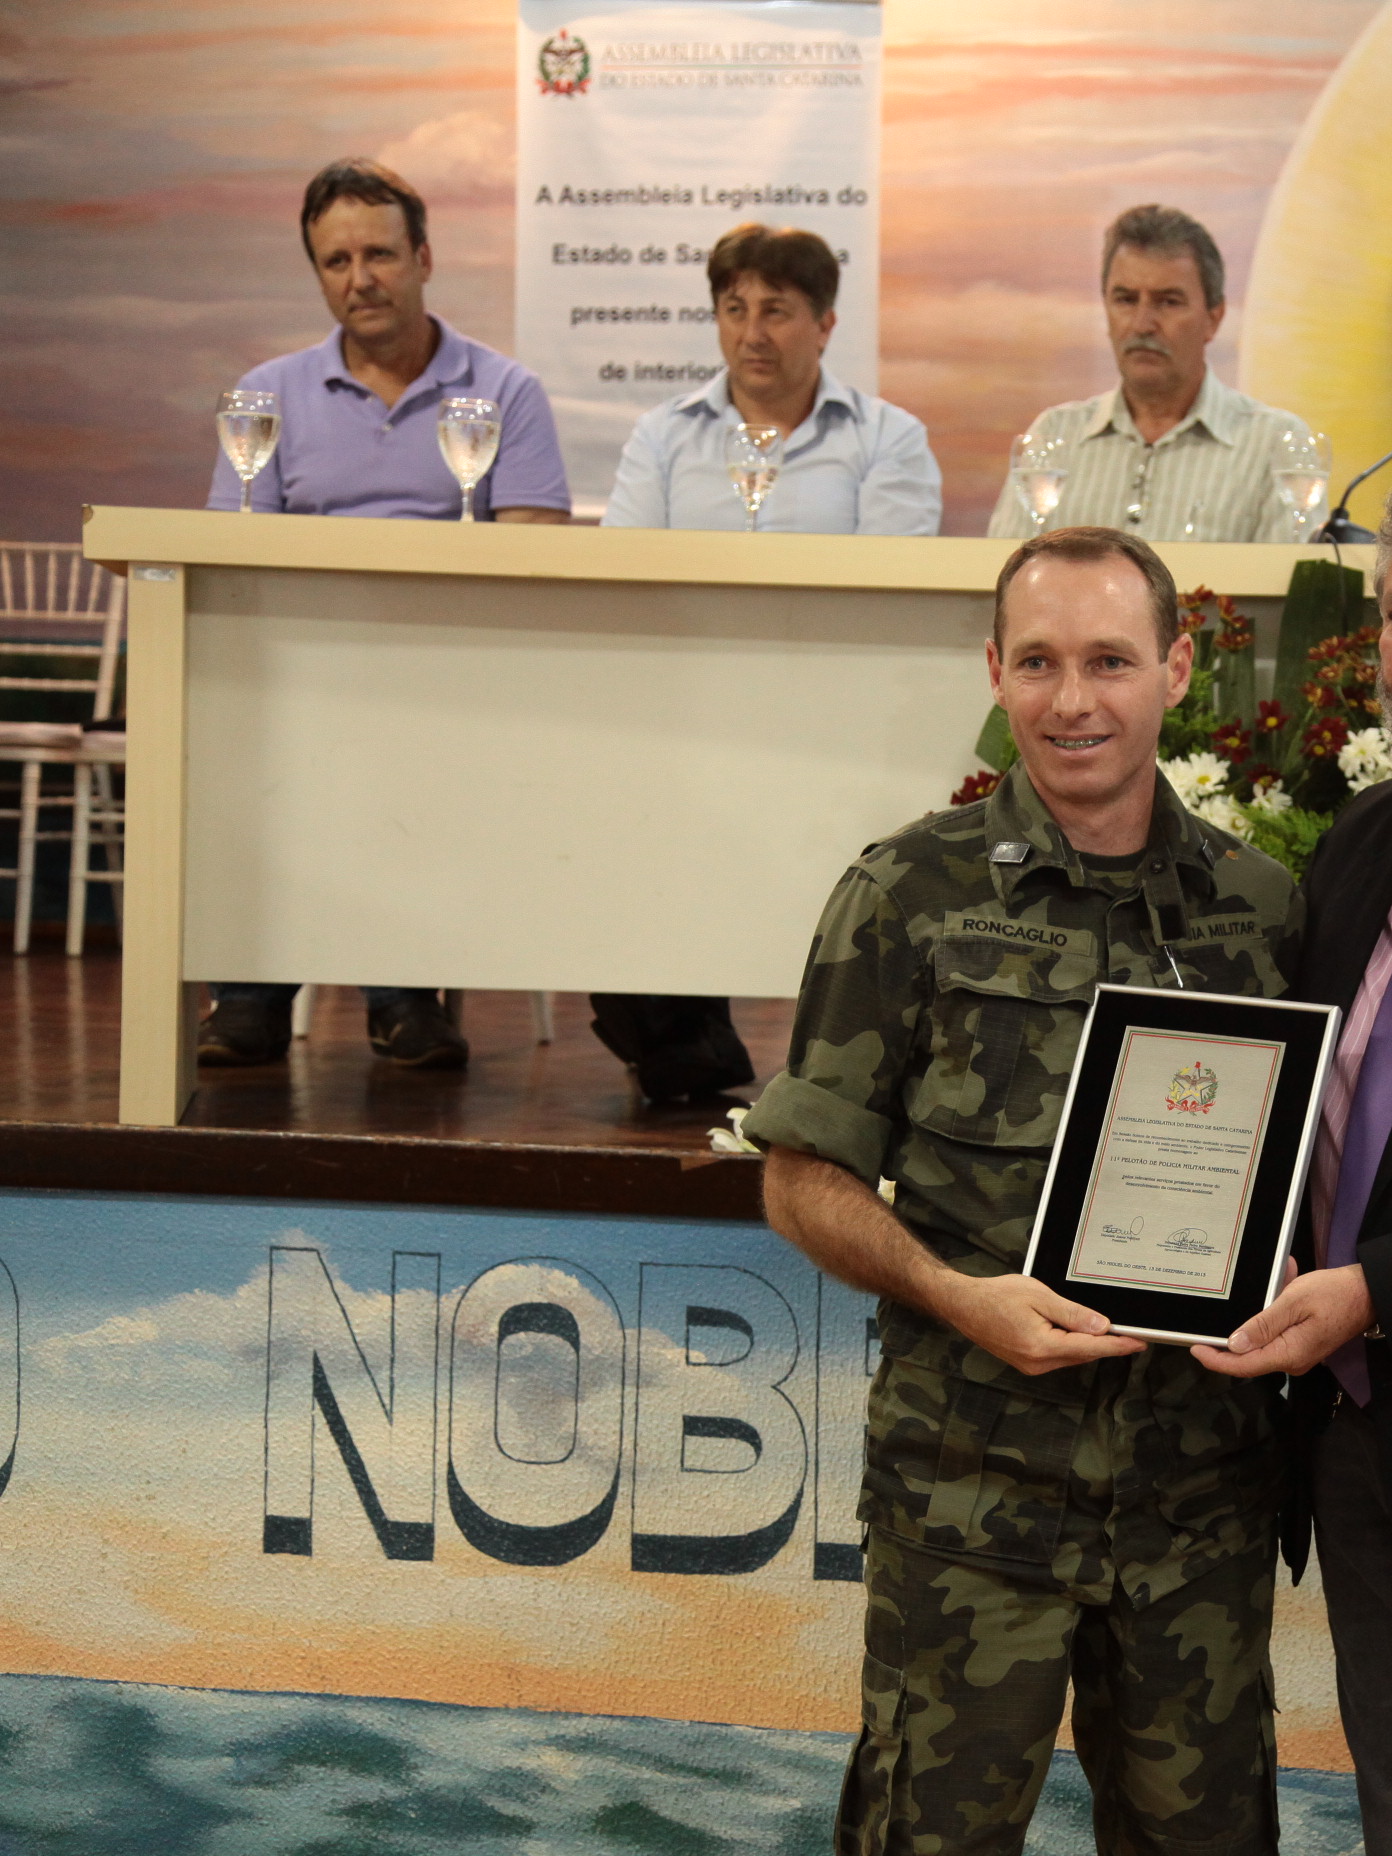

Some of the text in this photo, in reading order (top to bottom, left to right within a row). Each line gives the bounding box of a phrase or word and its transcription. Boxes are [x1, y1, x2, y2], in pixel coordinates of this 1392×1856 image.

[731, 42, 863, 61] LEGISLATIVA
[536, 184, 868, 210] A Assembleia Legislativa do
[553, 243, 632, 264] Estado
[640, 243, 666, 264] de
[571, 305, 671, 327] presente
[599, 361, 626, 381] de
[962, 918, 1068, 947] RONCAGLIO
[1208, 920, 1255, 938] MILITAR
[1146, 1118, 1176, 1127] LEGISLATIVA
[1122, 1156, 1148, 1165] PELOTÃO
[1183, 1164, 1206, 1172] MILITAR
[1207, 1166, 1240, 1174] AMBIENTAL
